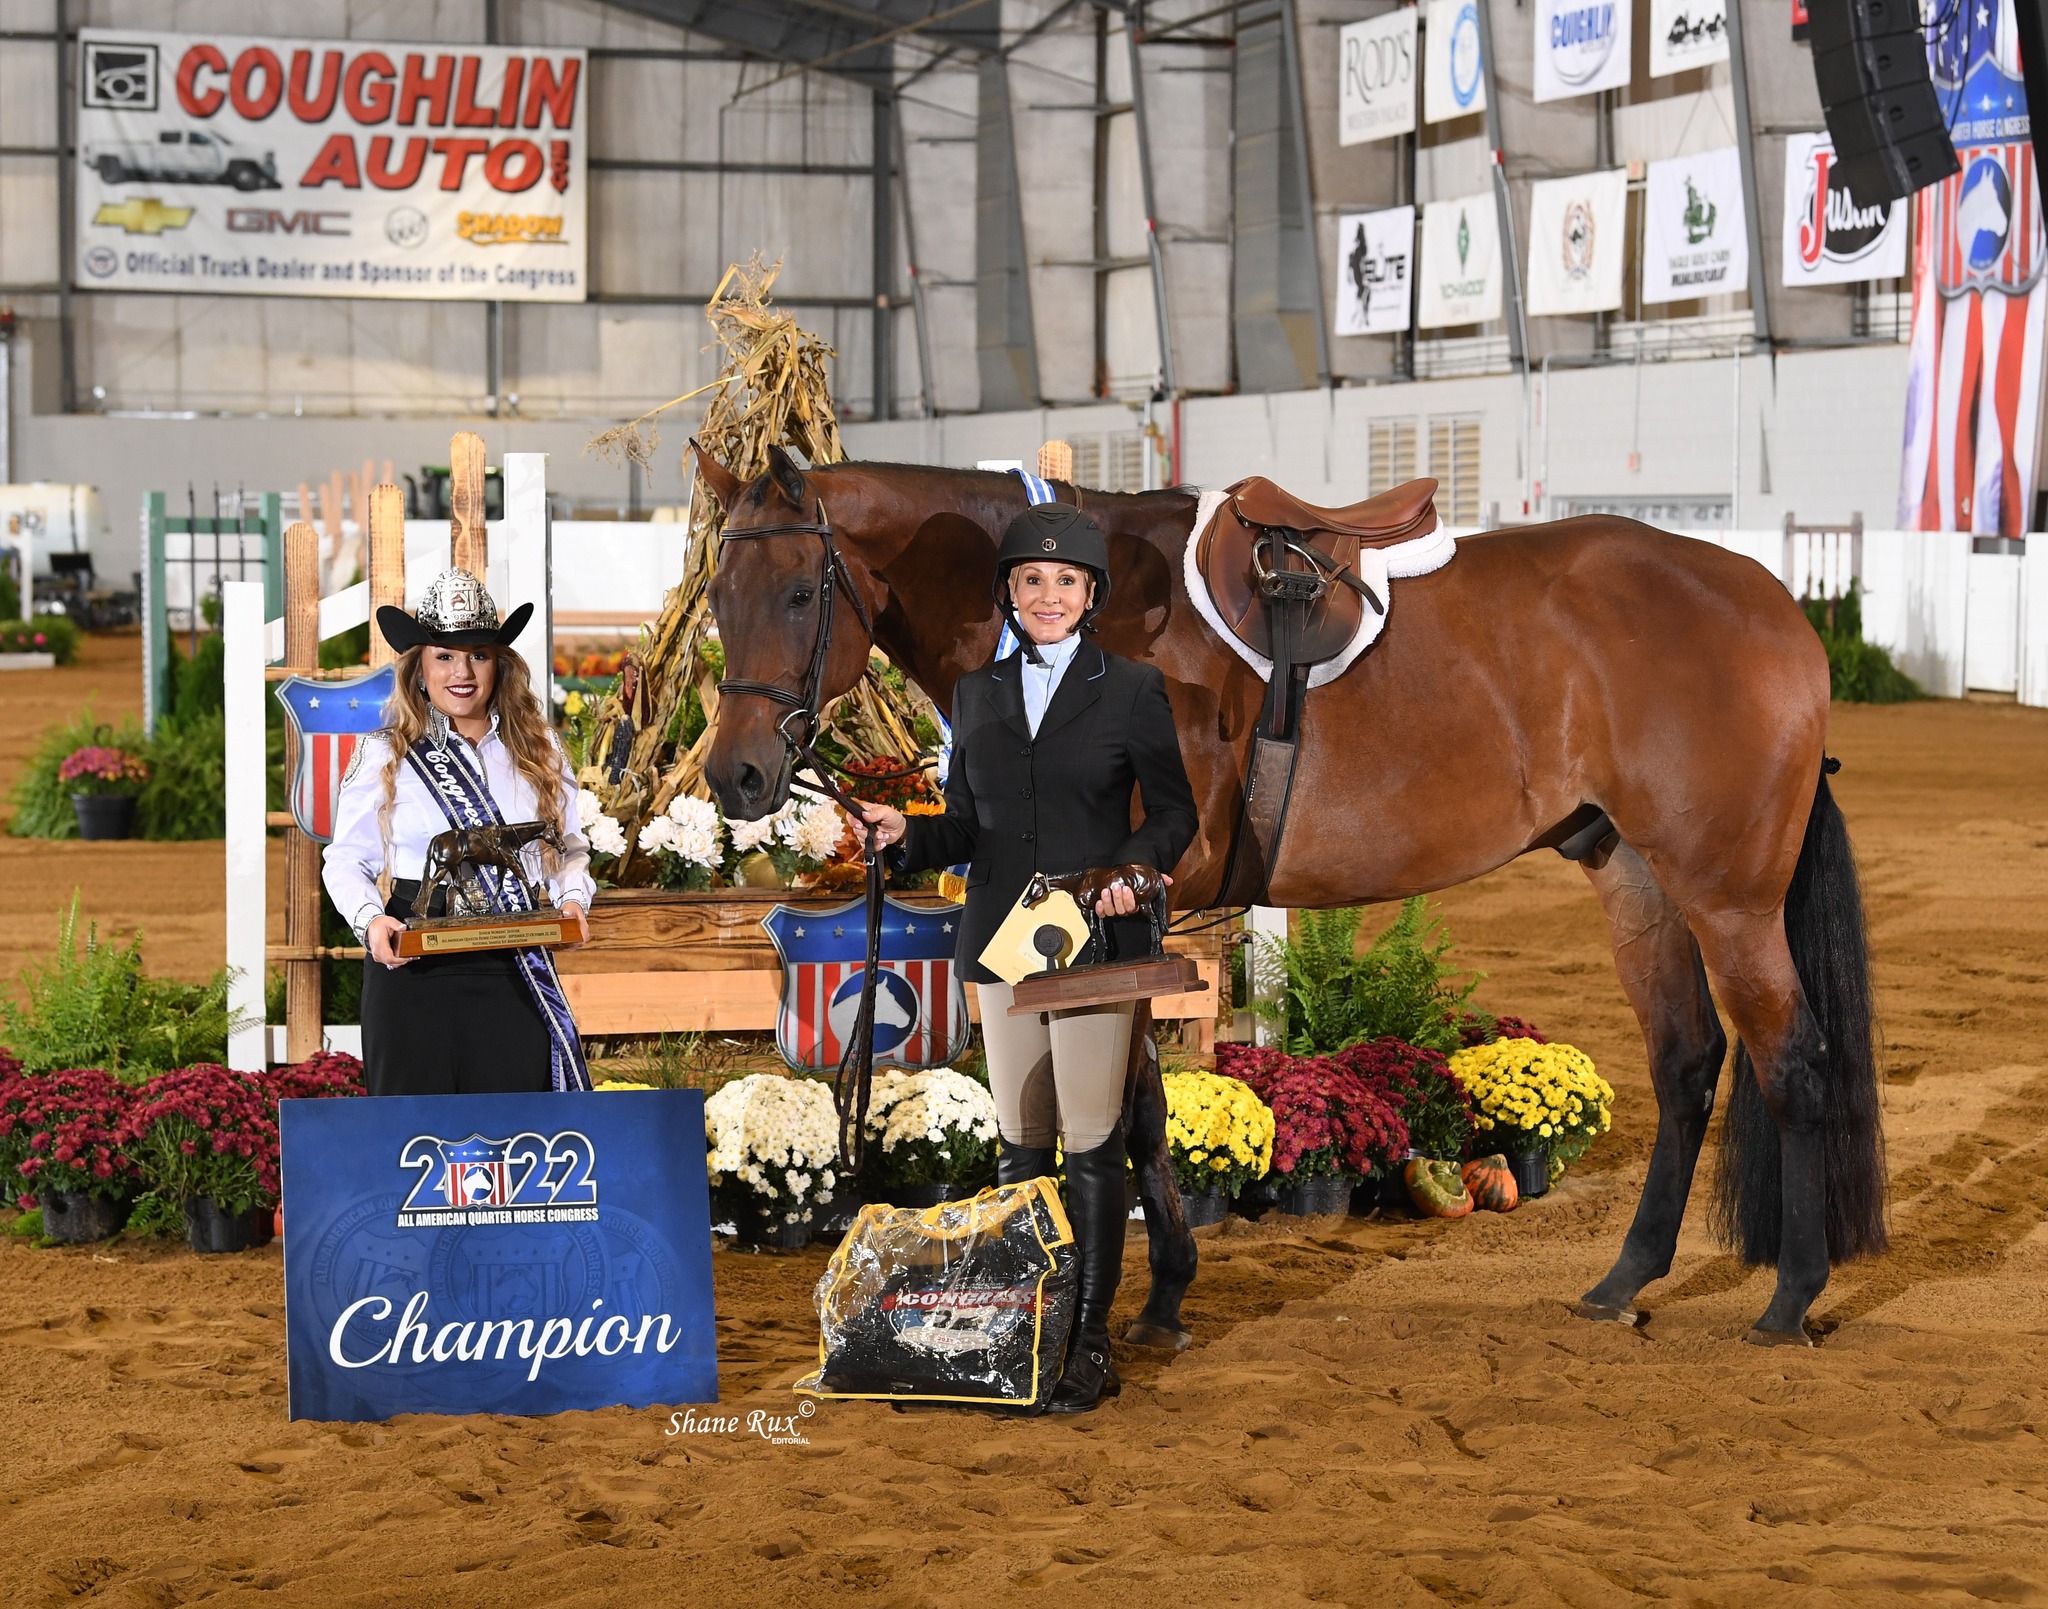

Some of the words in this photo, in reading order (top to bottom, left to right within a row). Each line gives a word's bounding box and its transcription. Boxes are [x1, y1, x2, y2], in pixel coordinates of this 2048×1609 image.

[176, 43, 581, 130] COUGHLIN
[1347, 29, 1411, 104] ROD'S
[298, 134, 545, 193] AUTO
[226, 208, 352, 236] GMC
[126, 252, 195, 274] Official
[201, 255, 251, 277] Truck
[257, 257, 316, 279] Dealer
[321, 260, 355, 281] and
[359, 261, 432, 286] Sponsor
[437, 261, 455, 283] of
[461, 262, 488, 283] the
[494, 263, 577, 289] Congress
[425, 750, 483, 827] Congres
[397, 1214, 414, 1228] ALL
[415, 1213, 466, 1226] AMERICAN
[467, 1211, 513, 1226] QUARTER
[514, 1210, 546, 1224] HORSE
[547, 1208, 599, 1222] CONGRESS
[329, 1290, 682, 1382] Champion
